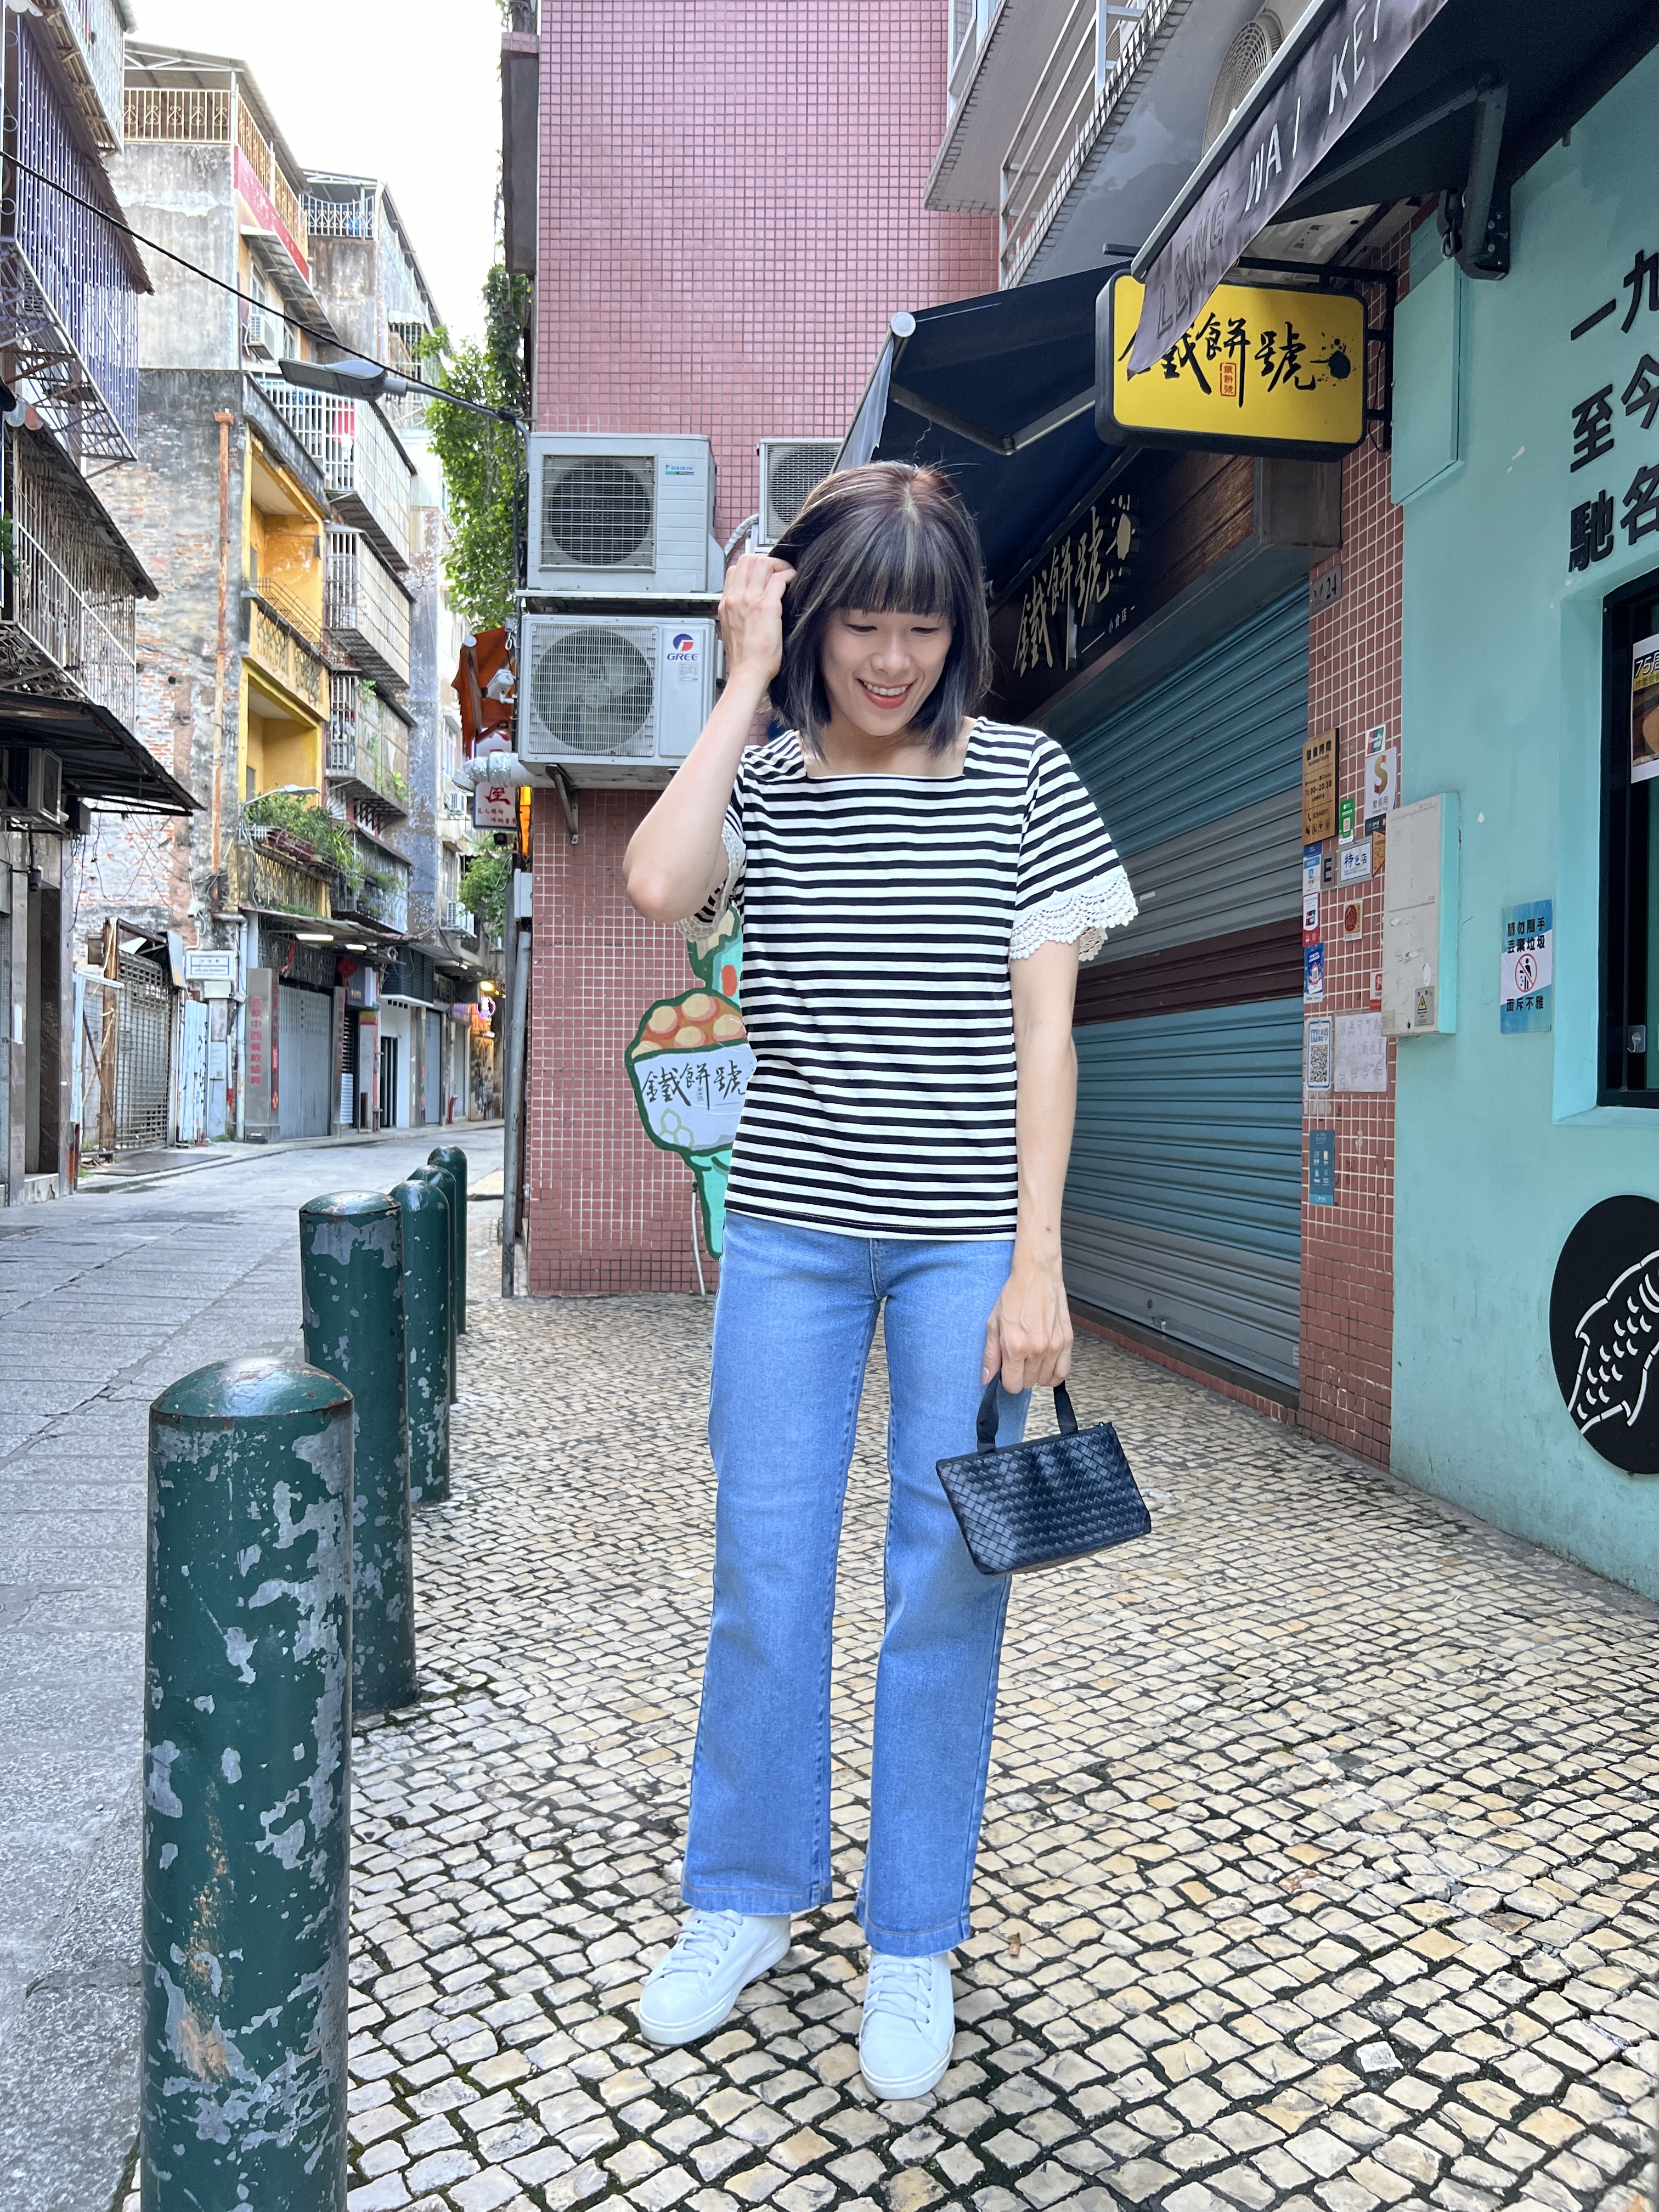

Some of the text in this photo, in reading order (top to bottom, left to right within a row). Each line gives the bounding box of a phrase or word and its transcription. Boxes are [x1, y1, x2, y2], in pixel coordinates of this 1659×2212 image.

[1245, 95, 1301, 212] WAI
[667, 653, 699, 661] GREE
[1344, 851, 1368, 869] 特色店
[1507, 916, 1545, 937] 請勿隨手
[1506, 995, 1544, 1013] 面斥不雅
[642, 1059, 746, 1110] 鐵餅號
